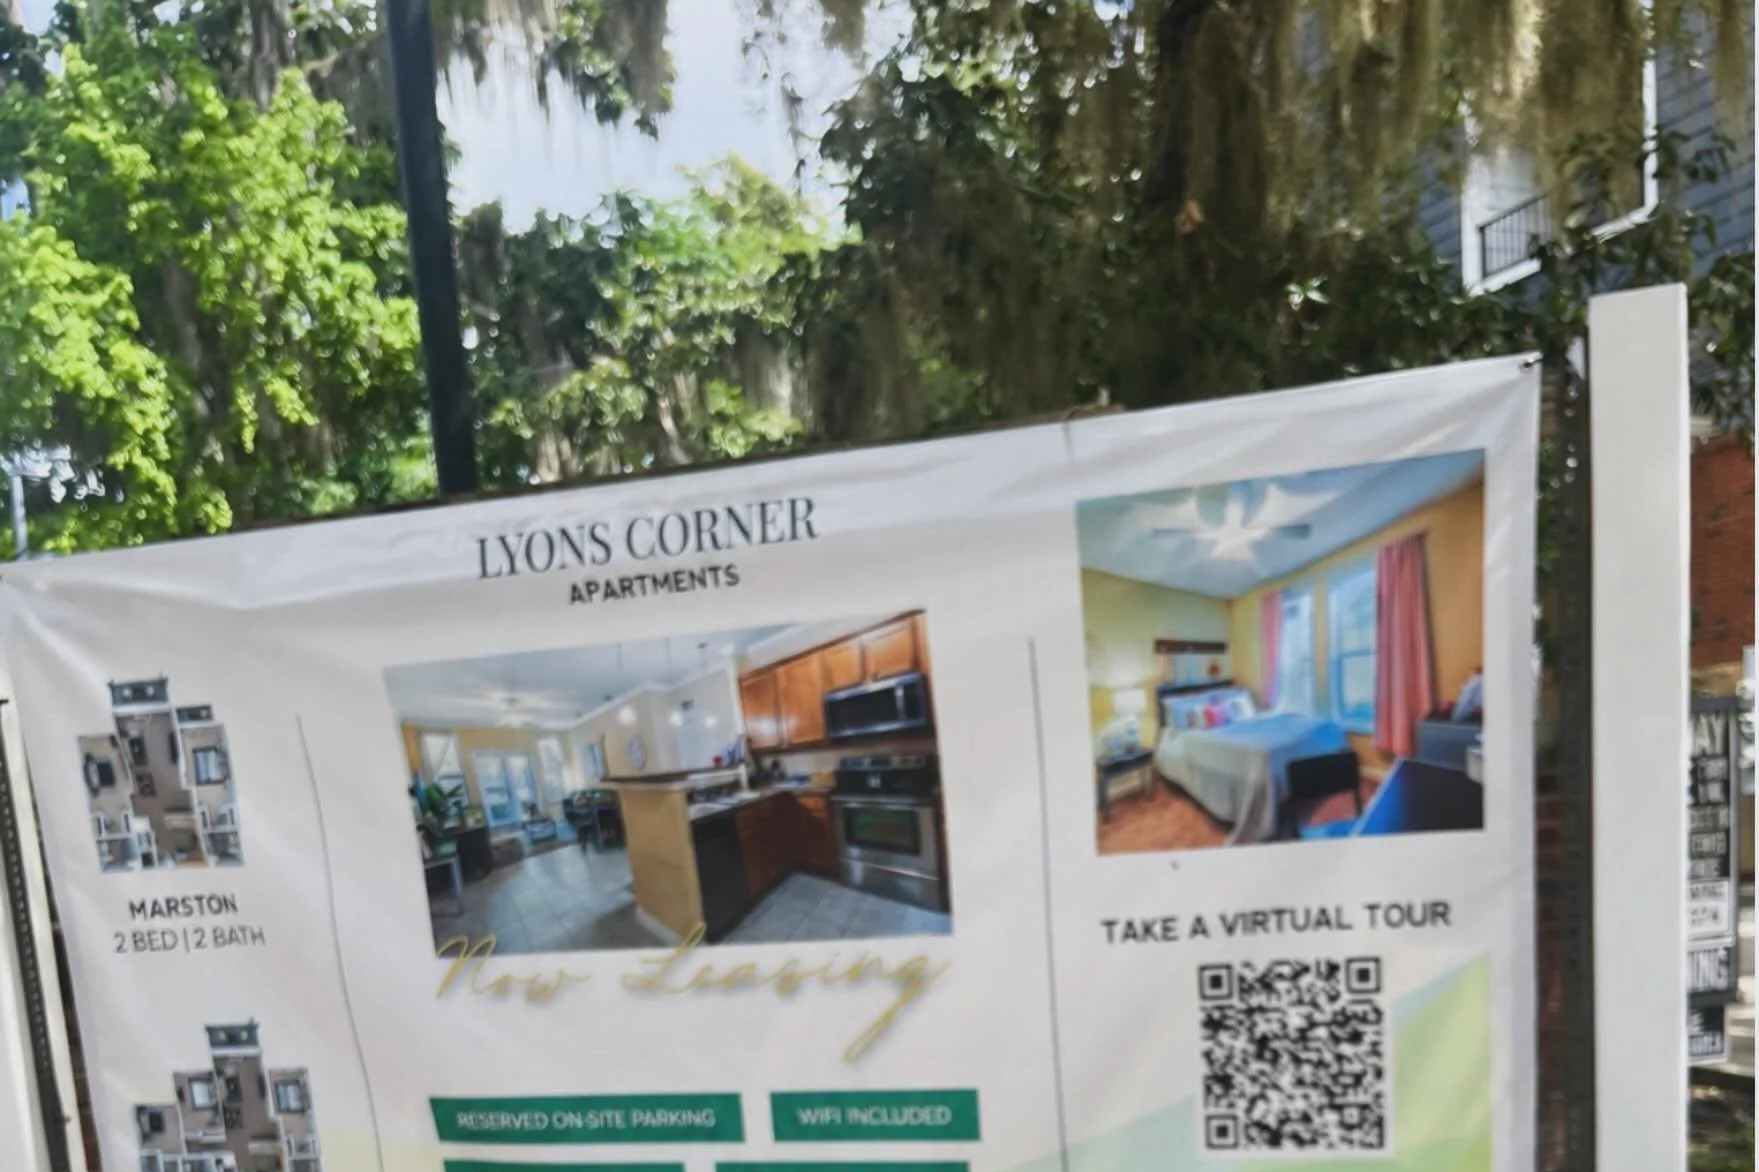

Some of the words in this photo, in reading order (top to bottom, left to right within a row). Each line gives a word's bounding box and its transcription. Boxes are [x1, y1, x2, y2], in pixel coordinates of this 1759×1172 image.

[476, 521, 613, 580] LYONS
[625, 497, 820, 562] CORNER
[569, 564, 741, 605] APARTMENTS
[129, 893, 239, 920] MARSTON
[1100, 916, 1180, 944] TAKE
[1188, 915, 1210, 939] A
[1219, 906, 1353, 937] VIRTUAL
[1364, 900, 1453, 928] TOUR
[212, 924, 266, 948] BATH
[434, 933, 592, 1004] Now
[620, 921, 952, 1063] Leasing
[457, 1111, 549, 1131] RESERVED
[631, 1108, 717, 1128] PARKING
[796, 1106, 842, 1126] WIFI
[846, 1104, 953, 1126] INCLUDED
